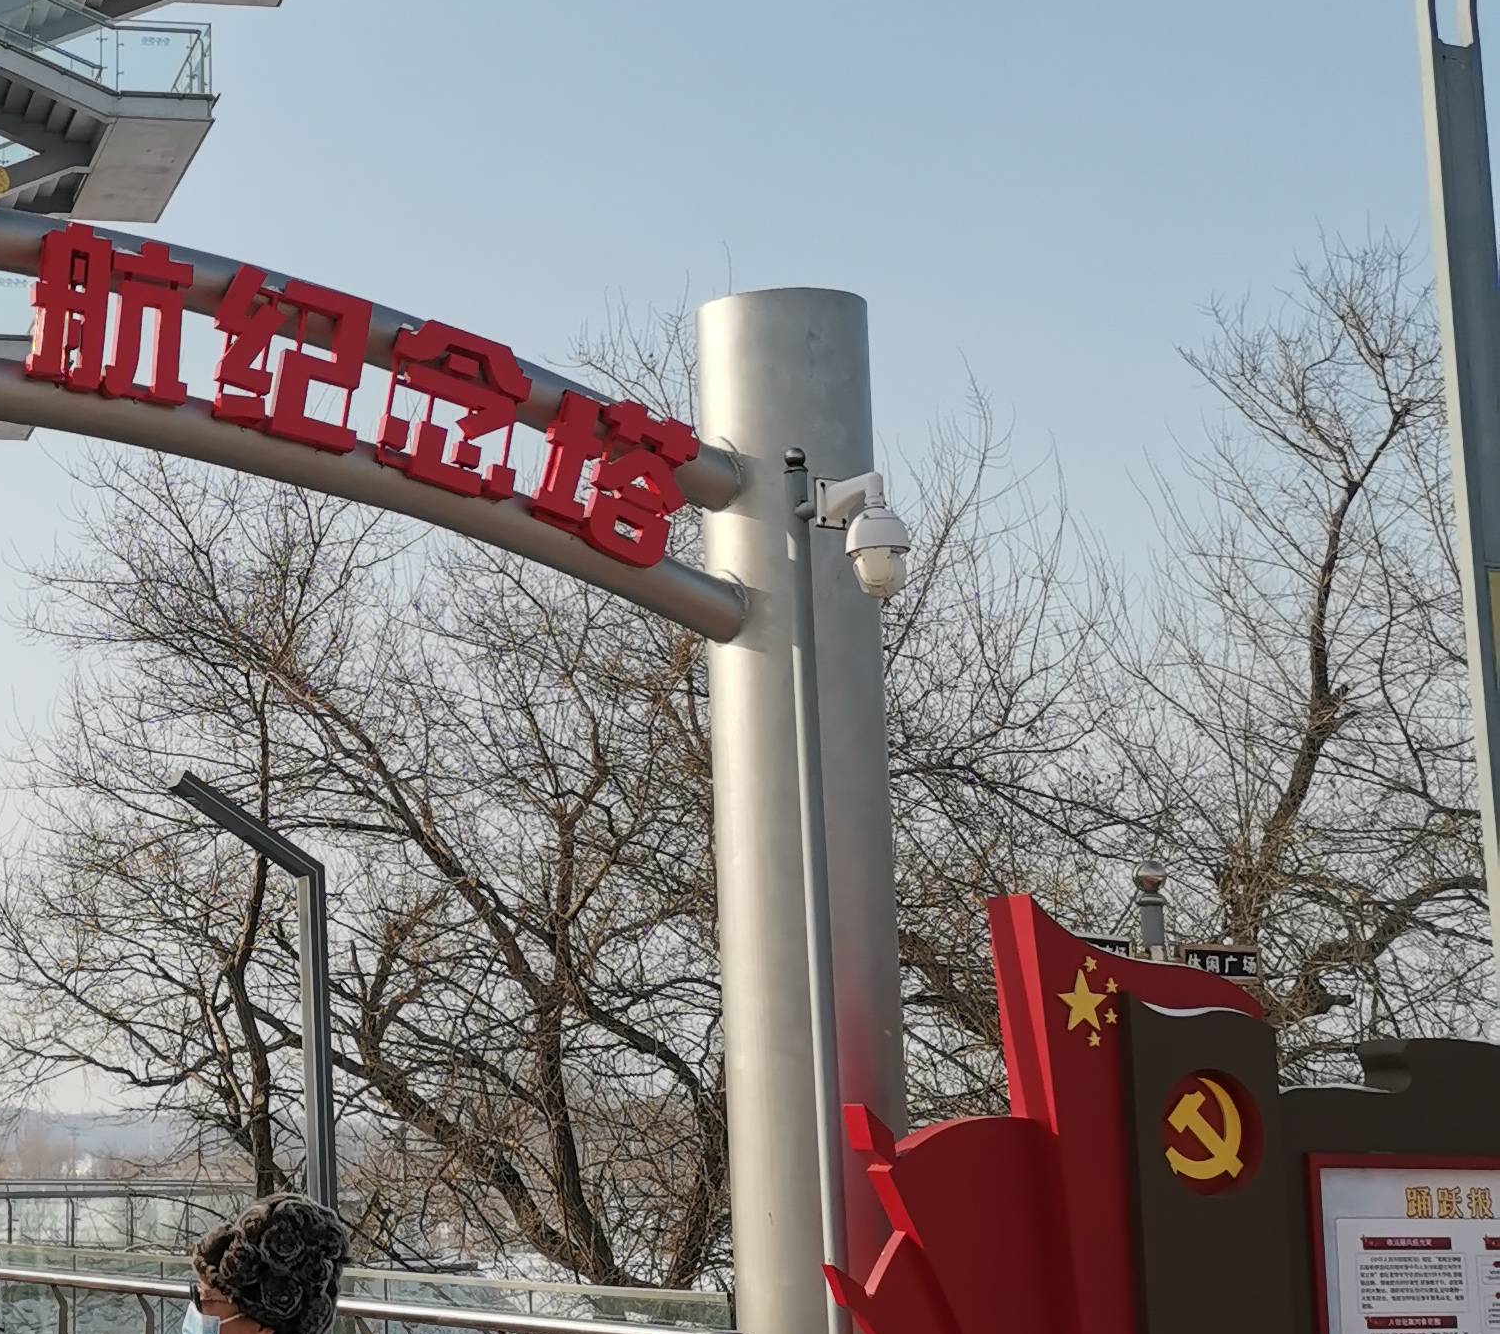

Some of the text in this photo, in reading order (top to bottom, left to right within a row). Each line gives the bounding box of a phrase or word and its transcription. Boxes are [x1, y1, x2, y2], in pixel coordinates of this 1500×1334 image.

[1187, 953, 1257, 975] 休闲广场
[1405, 1186, 1494, 1219] 踊跃报
